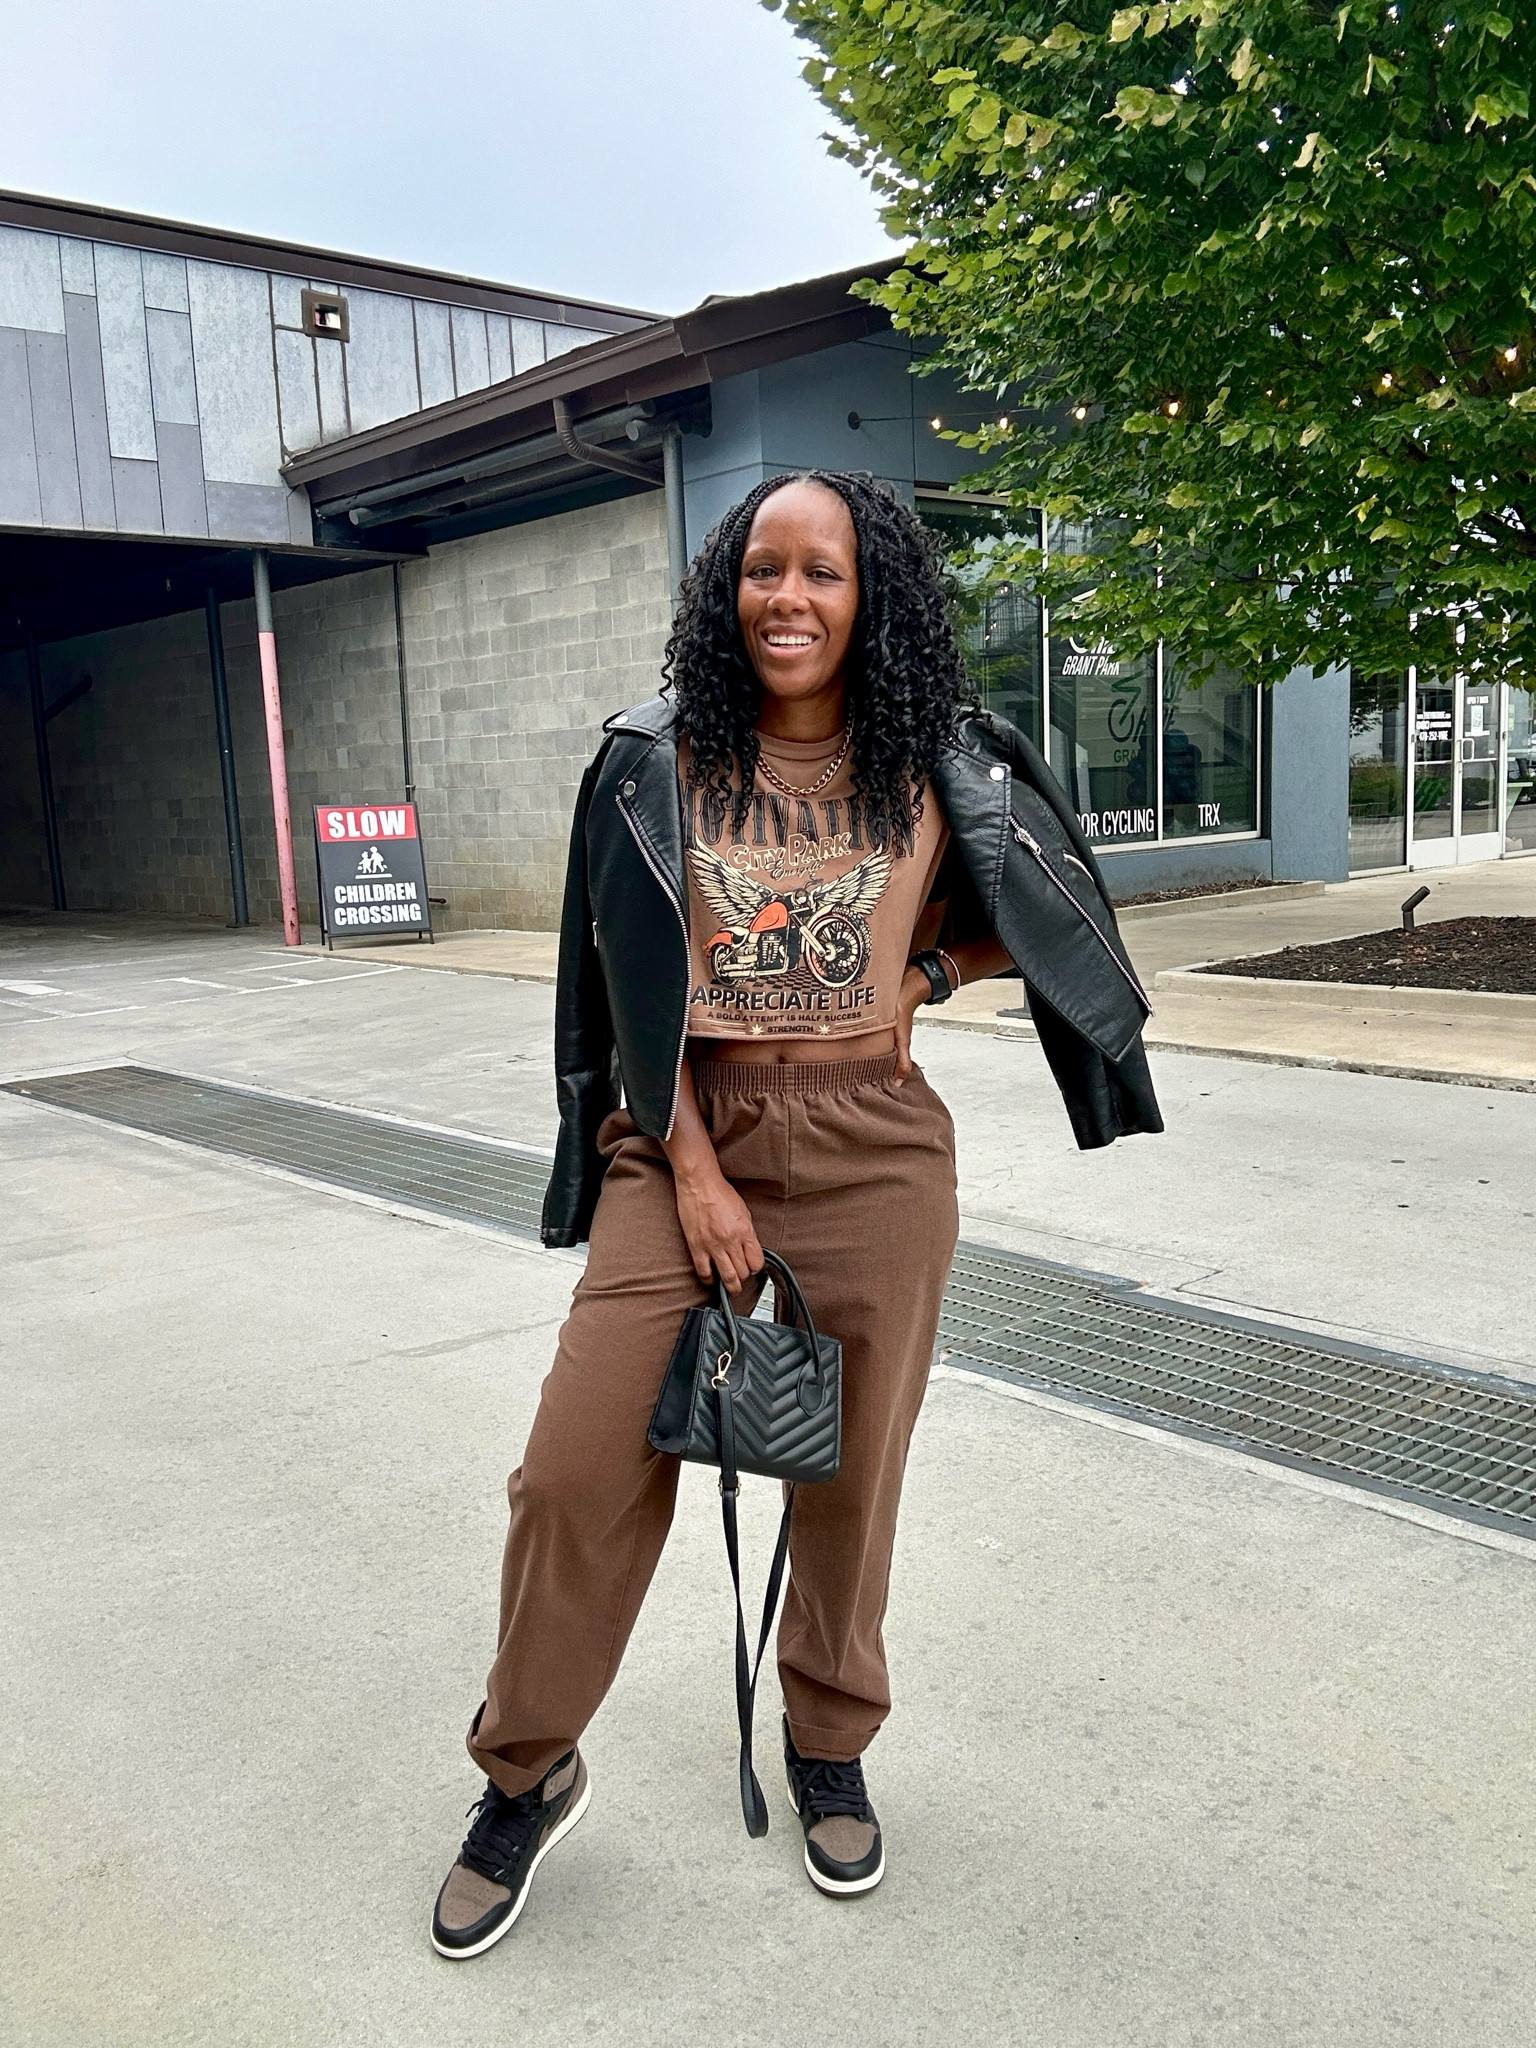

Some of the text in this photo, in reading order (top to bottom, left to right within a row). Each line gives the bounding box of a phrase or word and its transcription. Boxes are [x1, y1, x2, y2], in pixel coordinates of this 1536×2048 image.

[1062, 655, 1098, 676] GRANT
[327, 809, 406, 839] SLOW
[1102, 808, 1155, 836] CYCLING
[1197, 803, 1221, 828] TRX
[726, 832, 852, 873] CITY PARK
[334, 882, 418, 904] CHILDREN
[334, 903, 422, 926] CROSSING
[690, 985, 877, 1012] APPRECIATE LIFE
[707, 1011, 714, 1019] A
[716, 1012, 741, 1021] BOLD
[787, 1014, 796, 1022] IS
[798, 1014, 822, 1022] HALF
[825, 1011, 862, 1021] SUCCESS
[767, 1025, 814, 1034] STRENGTH
